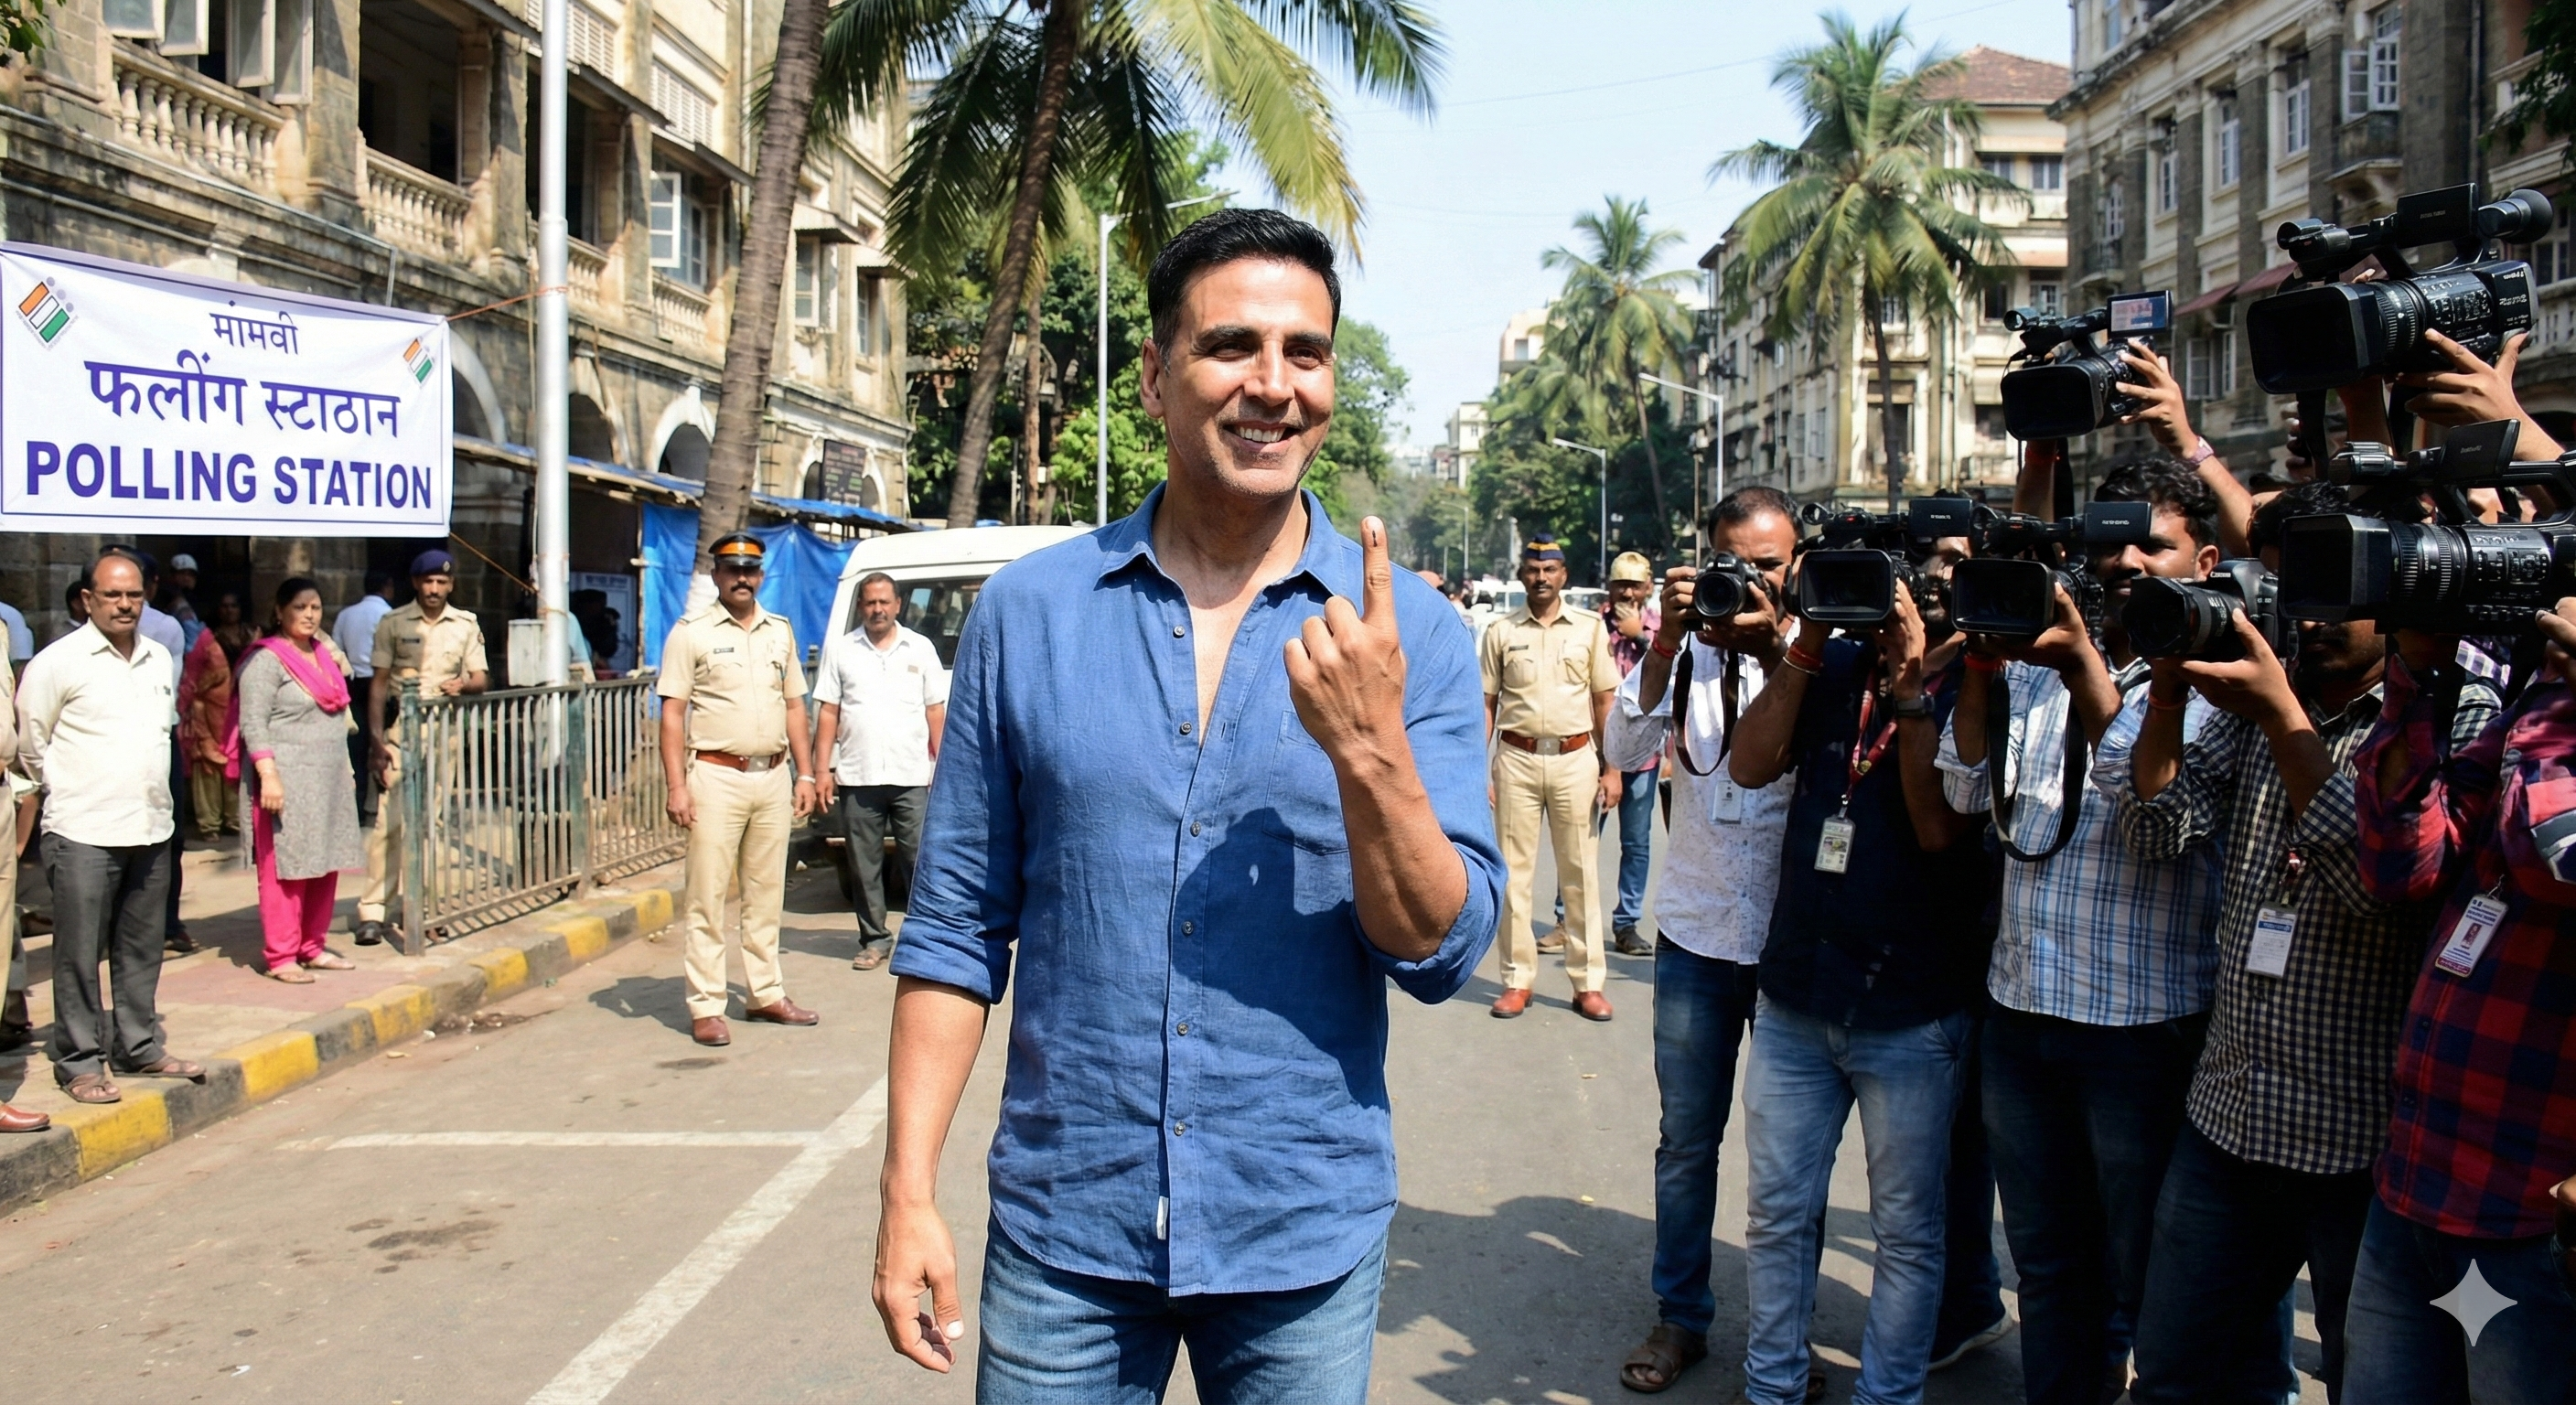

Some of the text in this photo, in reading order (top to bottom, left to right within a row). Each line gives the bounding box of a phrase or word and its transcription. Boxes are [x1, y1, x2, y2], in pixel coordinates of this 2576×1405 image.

[83, 349, 401, 438] फलींग स्टाठान
[27, 440, 431, 509] POLLING STATION
